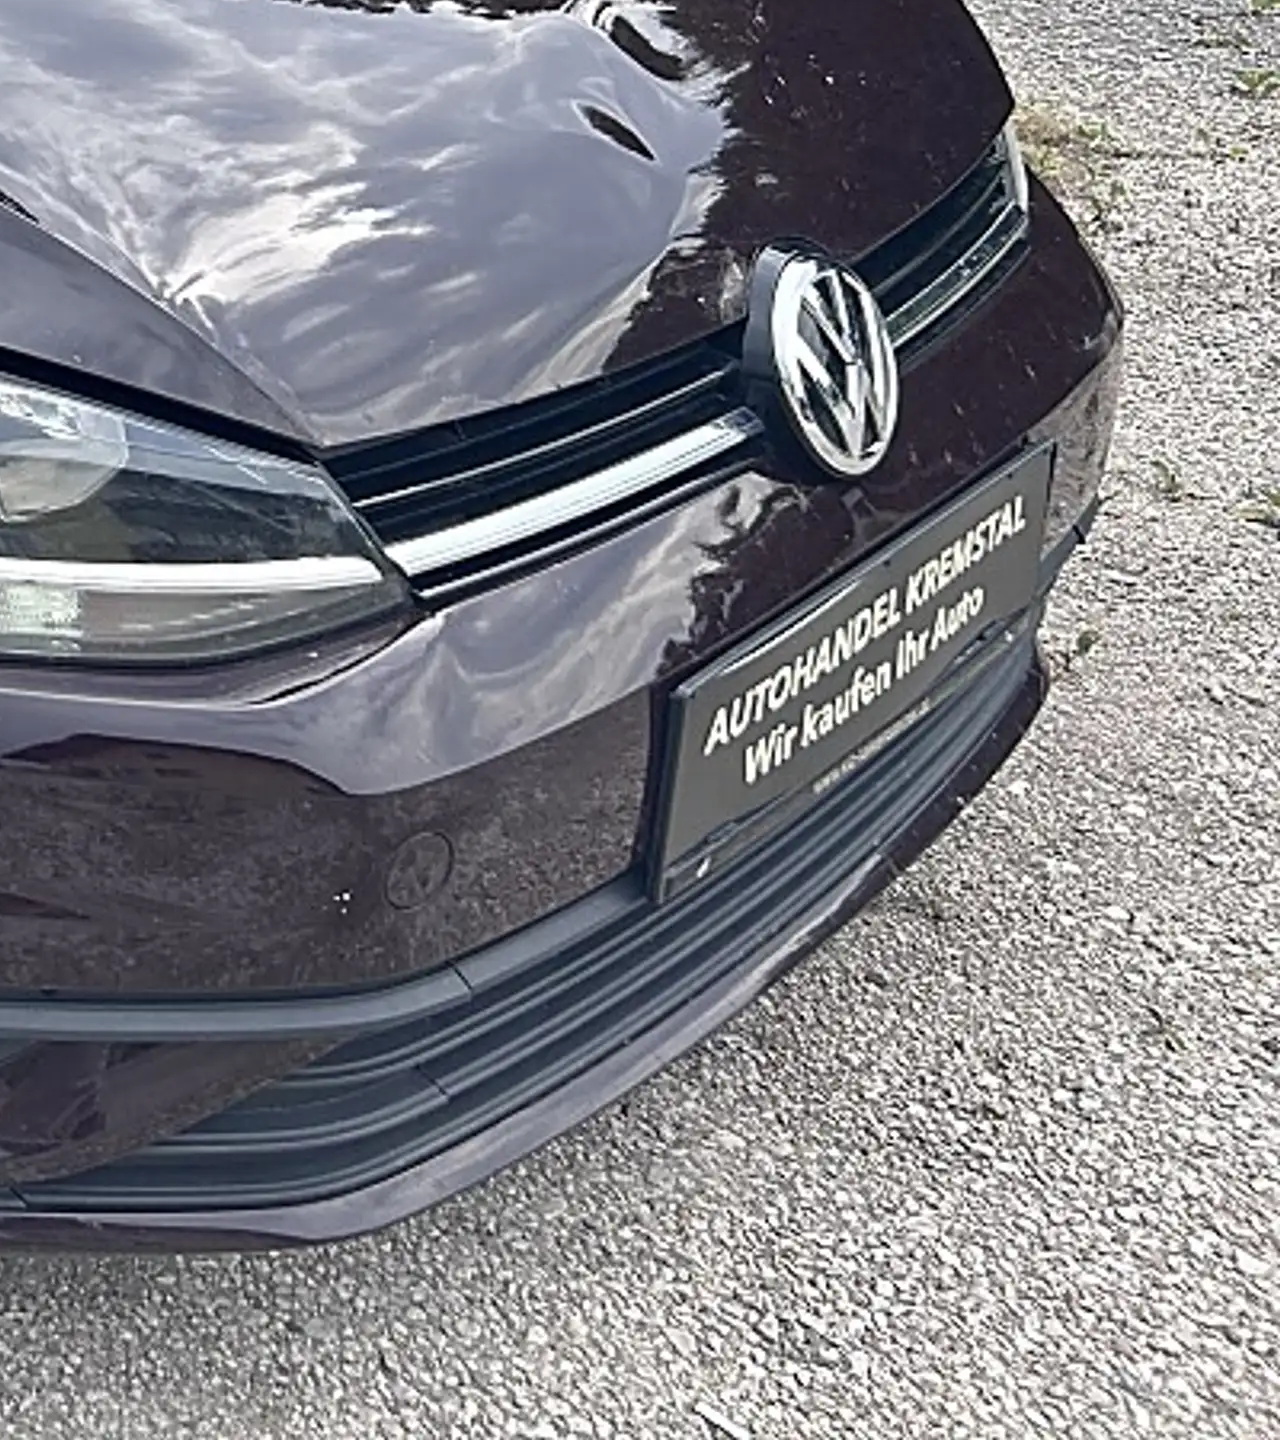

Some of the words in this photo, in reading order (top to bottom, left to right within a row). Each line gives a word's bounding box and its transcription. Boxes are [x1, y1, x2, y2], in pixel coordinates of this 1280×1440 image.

[771, 258, 899, 476] VW
[703, 586, 901, 757] AUTOHANDEL
[905, 495, 1027, 616] KREMSTAL
[743, 722, 798, 785] Wir
[800, 660, 891, 748] kaufen
[895, 628, 930, 681] Ihr
[930, 586, 985, 652] Auto
